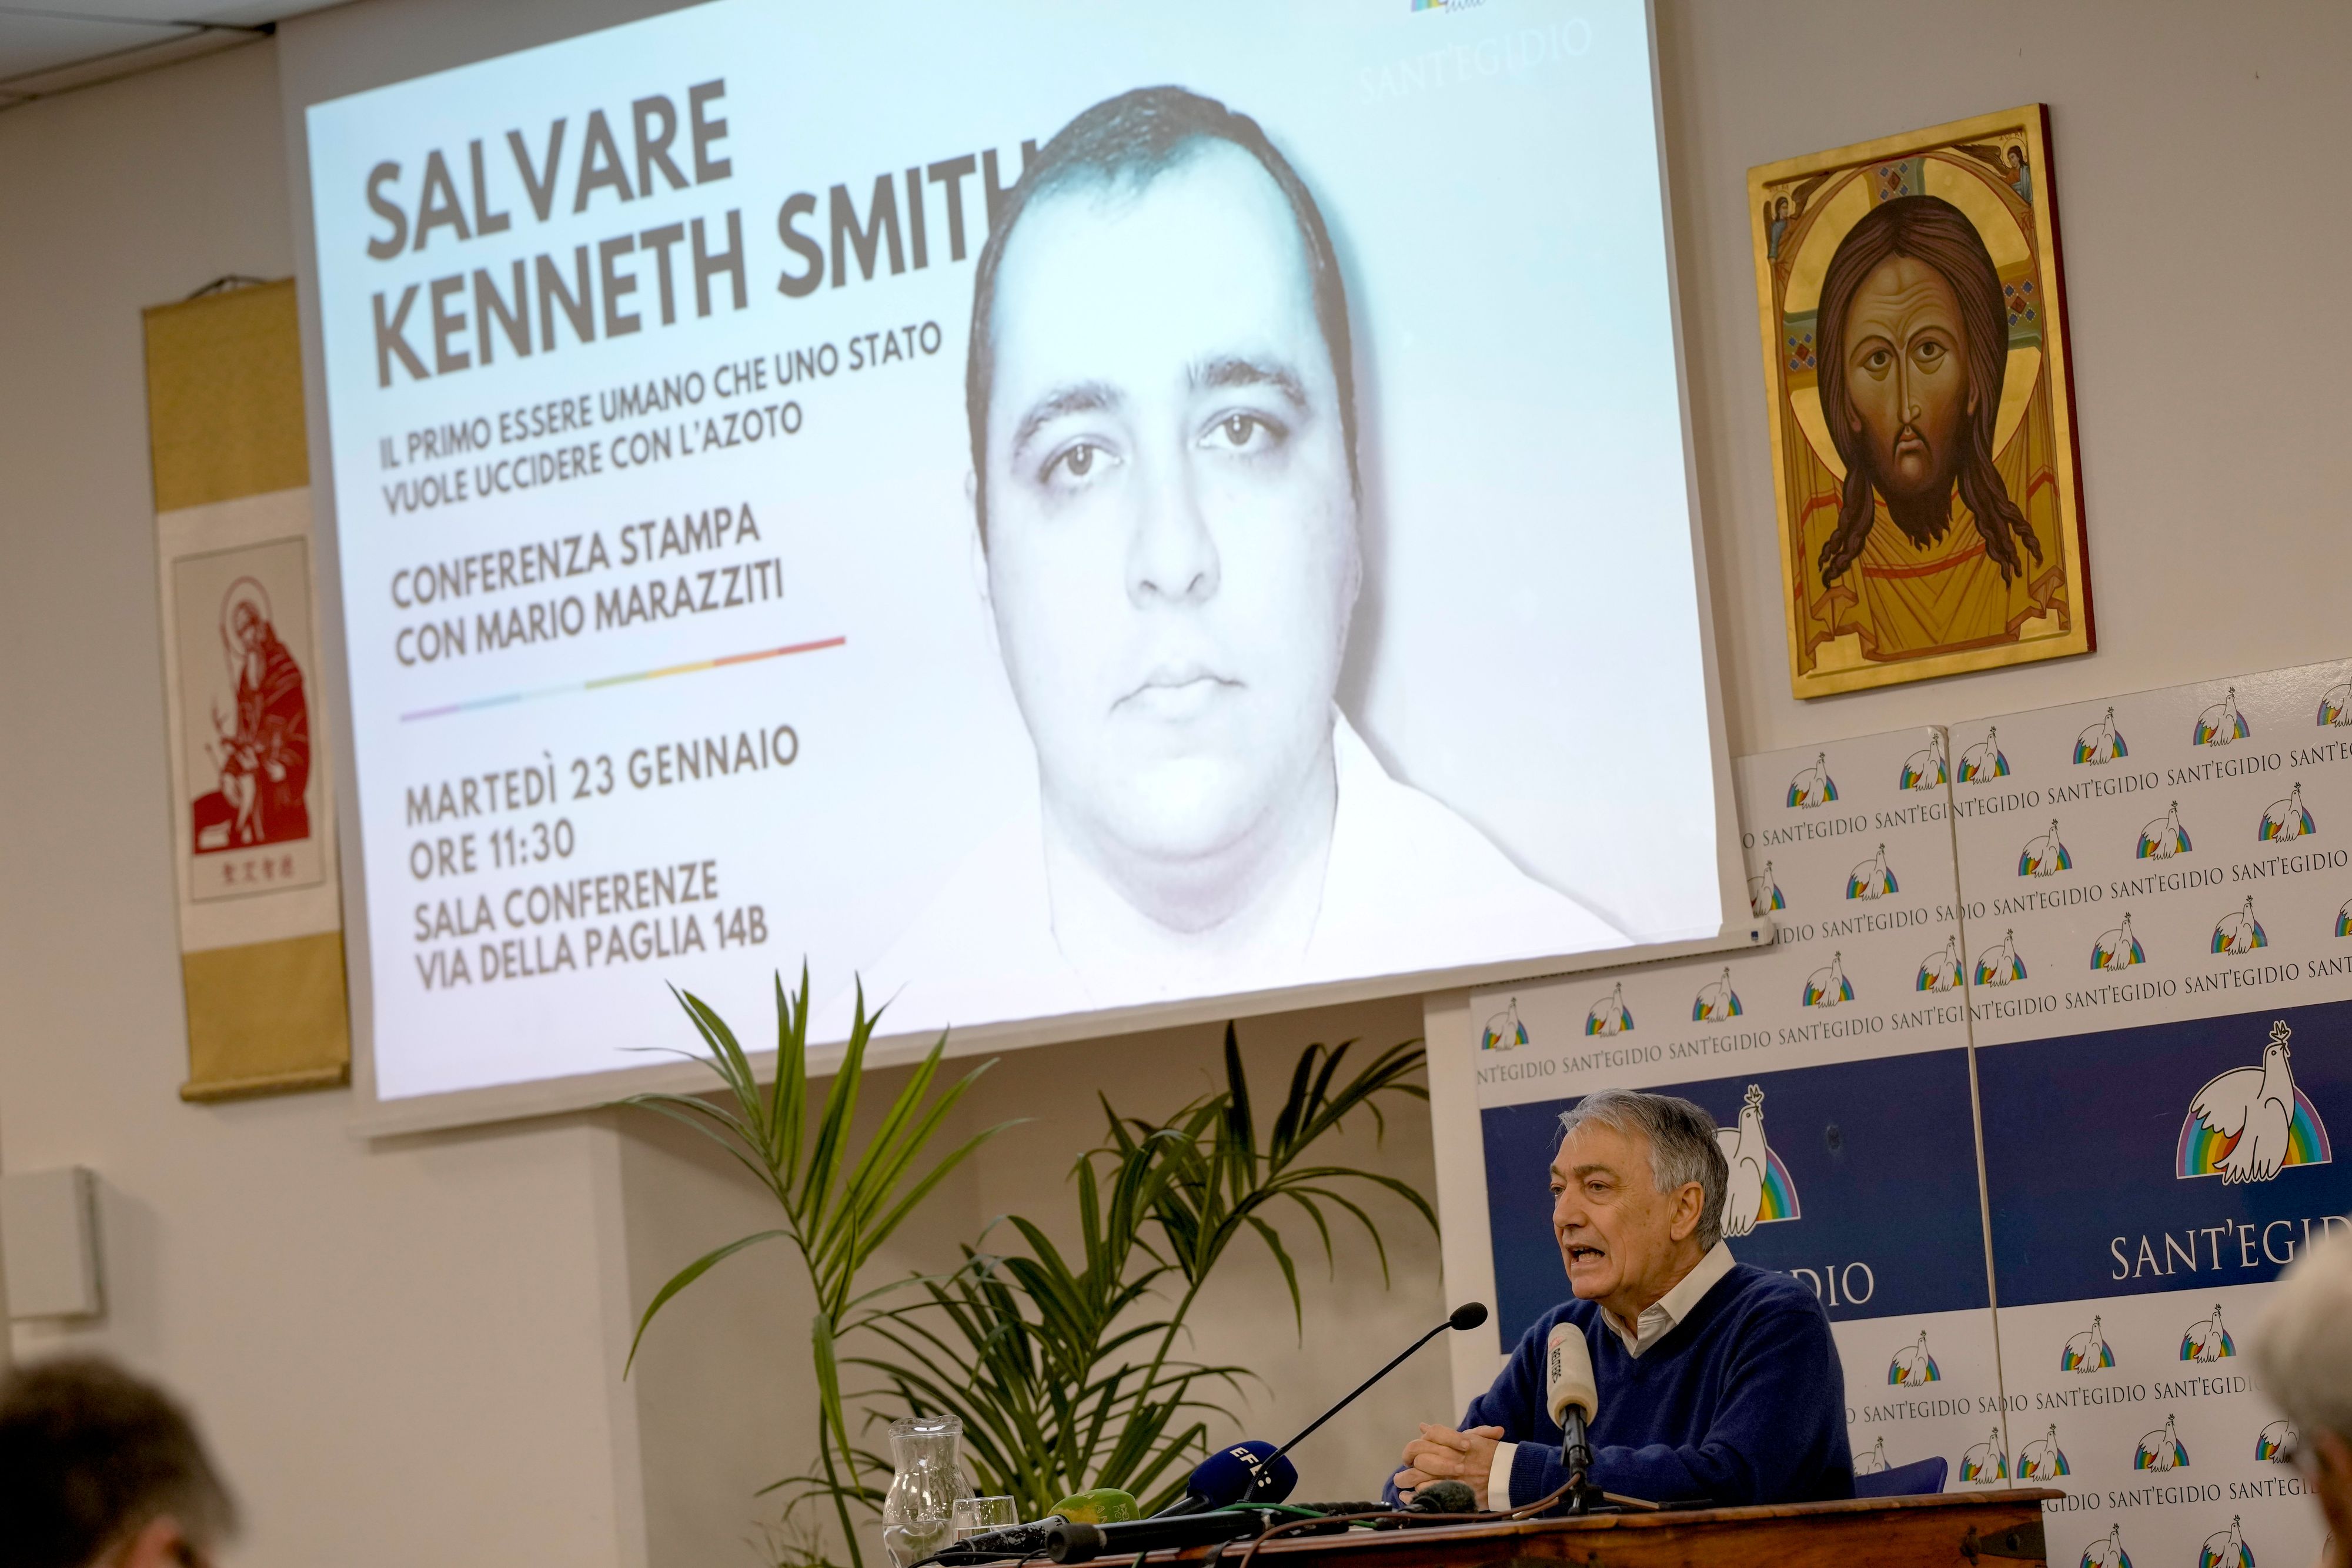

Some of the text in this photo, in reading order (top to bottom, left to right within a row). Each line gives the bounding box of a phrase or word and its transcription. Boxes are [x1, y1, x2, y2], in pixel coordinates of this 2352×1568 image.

[365, 77, 733, 261] SALVARE
[371, 208, 749, 389] KENNETH
[379, 320, 942, 470] IL PRIMO ESSERE UMANO CHE UNO STATO
[382, 402, 803, 515] VUOLE UCCIDERE CON L'AZOTO
[391, 505, 761, 609] CONFERENZA STAMPA
[395, 557, 784, 667] CON MARIO MARAZZITI
[406, 724, 799, 827] MARTEDÌ 23 GENNAIO
[2048, 772, 2159, 804] SANT'EGIDIO
[2167, 753, 2281, 786] SANT'EGIDIO
[2290, 741, 2352, 767] SANT'E
[410, 817, 574, 881] ORE 11:30
[1763, 815, 1867, 846] SANT'EGIDIO
[415, 859, 719, 942] SALA CONFERENZE
[1994, 885, 2102, 916] SANT'EGIDIO
[2111, 868, 2223, 899] SANT'EGIDIO
[2232, 850, 2347, 882] SANT'EGIDIO
[415, 905, 768, 991] VIA DELLA PAGLIA 14B
[1822, 908, 1927, 938] SANT'EGIDIO
[2066, 979, 2176, 1009] SANT'EGIDIO
[2185, 964, 2299, 994] SANT'EGIDIO
[1563, 1045, 1662, 1073] SANT'EGIDIO
[1669, 1031, 1771, 1059] SANT'EGIDIO
[1779, 1016, 1883, 1045] SANT'EGIDIO
[1864, 1398, 1970, 1422] SANT'EGIDIO
[2036, 1385, 2146, 1410] SANT'EGIDIO
[2109, 1484, 2220, 1509] SANT'EGIDIO
